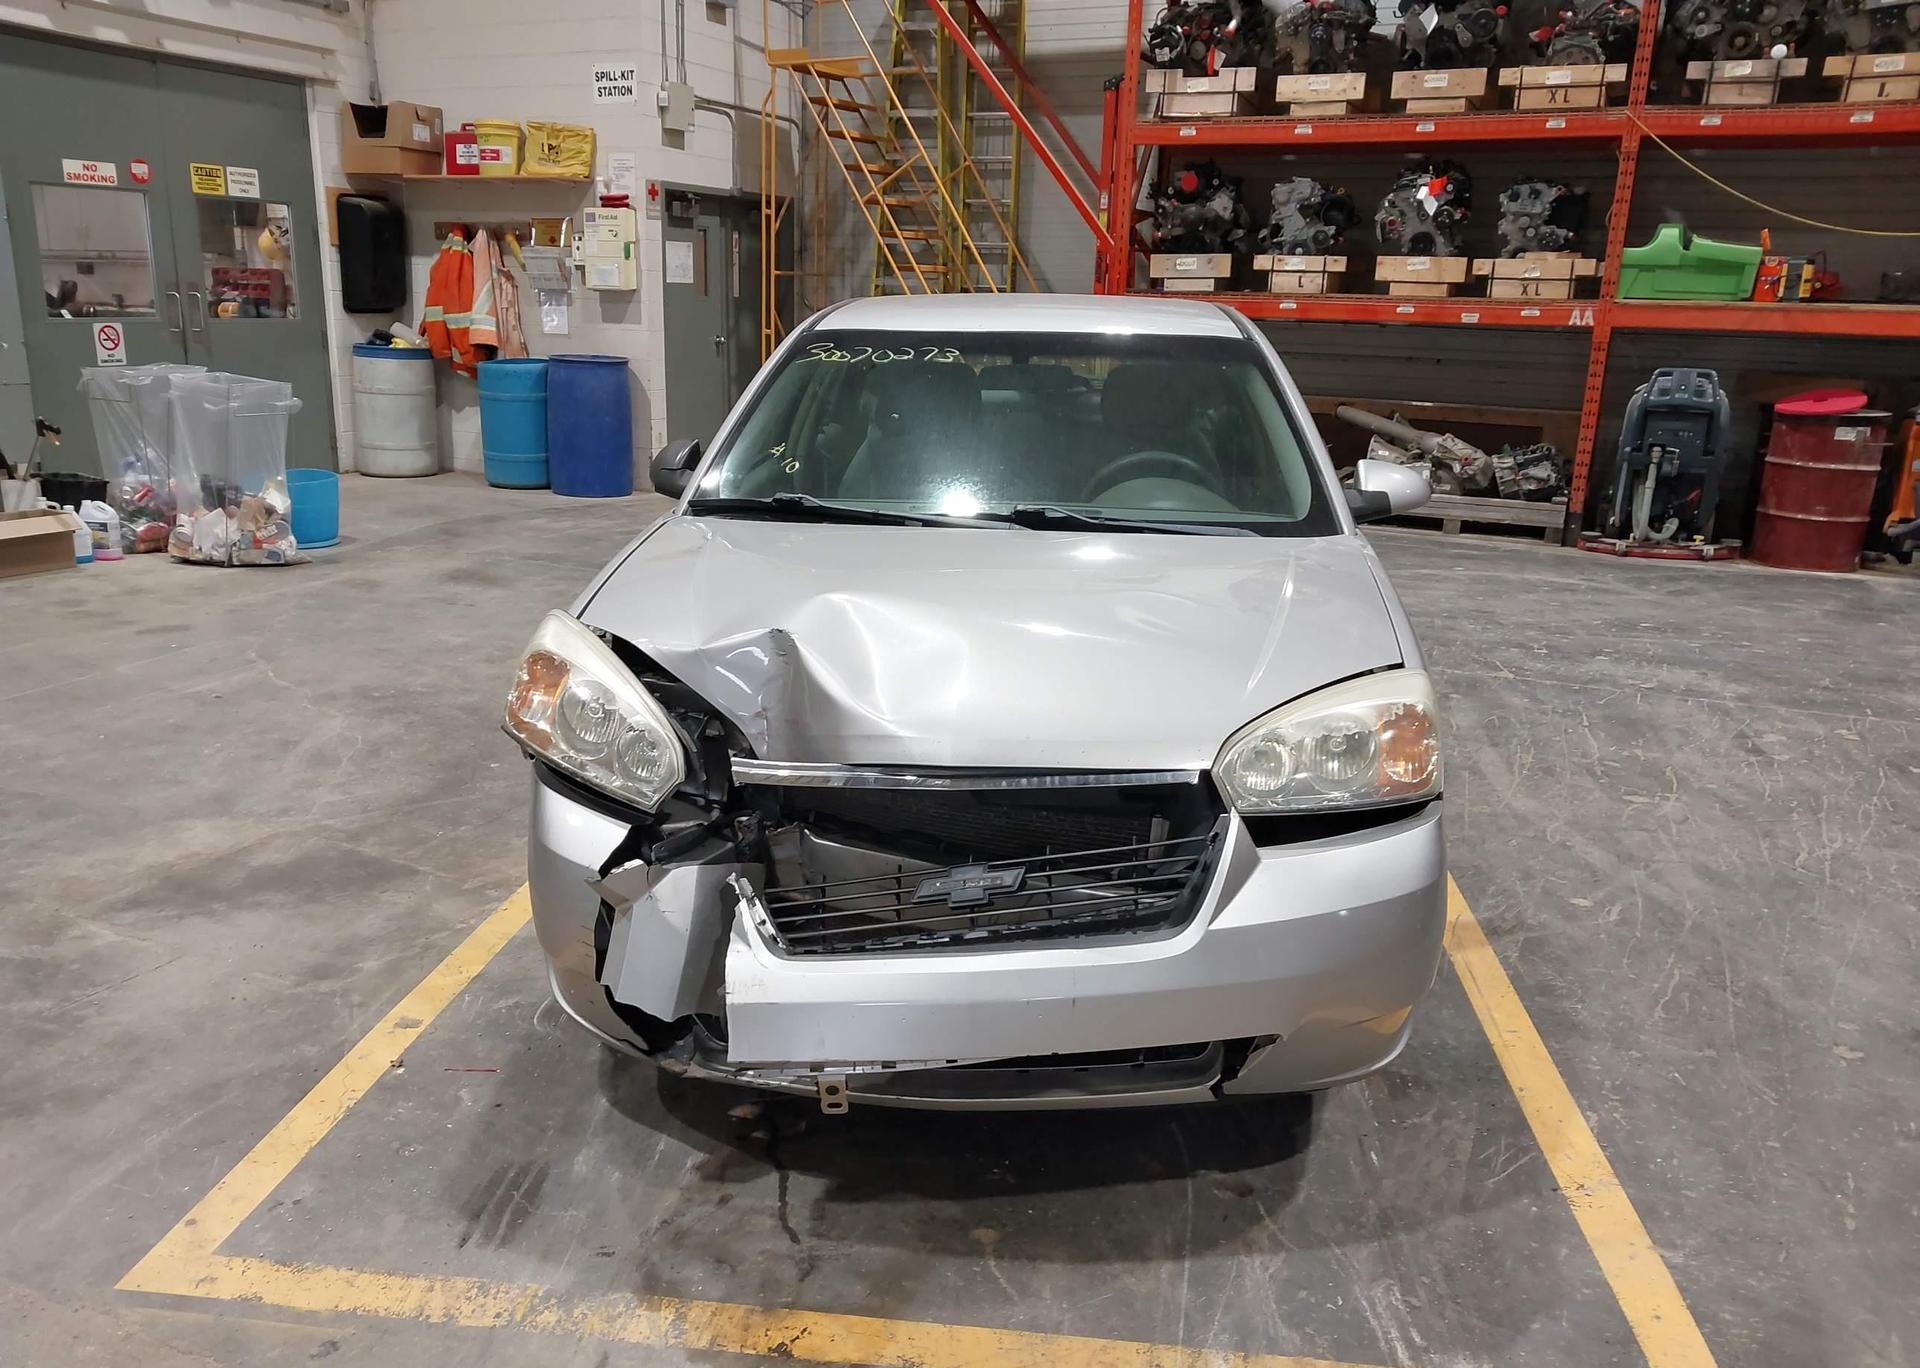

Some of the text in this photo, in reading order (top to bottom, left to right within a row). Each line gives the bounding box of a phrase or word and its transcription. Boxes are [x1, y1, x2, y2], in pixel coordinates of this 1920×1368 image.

[595, 70, 634, 82] SPILL-KIT
[597, 85, 632, 97] STATION
[82, 163, 97, 172] NO
[194, 168, 221, 177] CAUTION
[66, 172, 115, 184] SMOKING
[1298, 275, 1304, 288] L
[1569, 307, 1595, 327] AA
